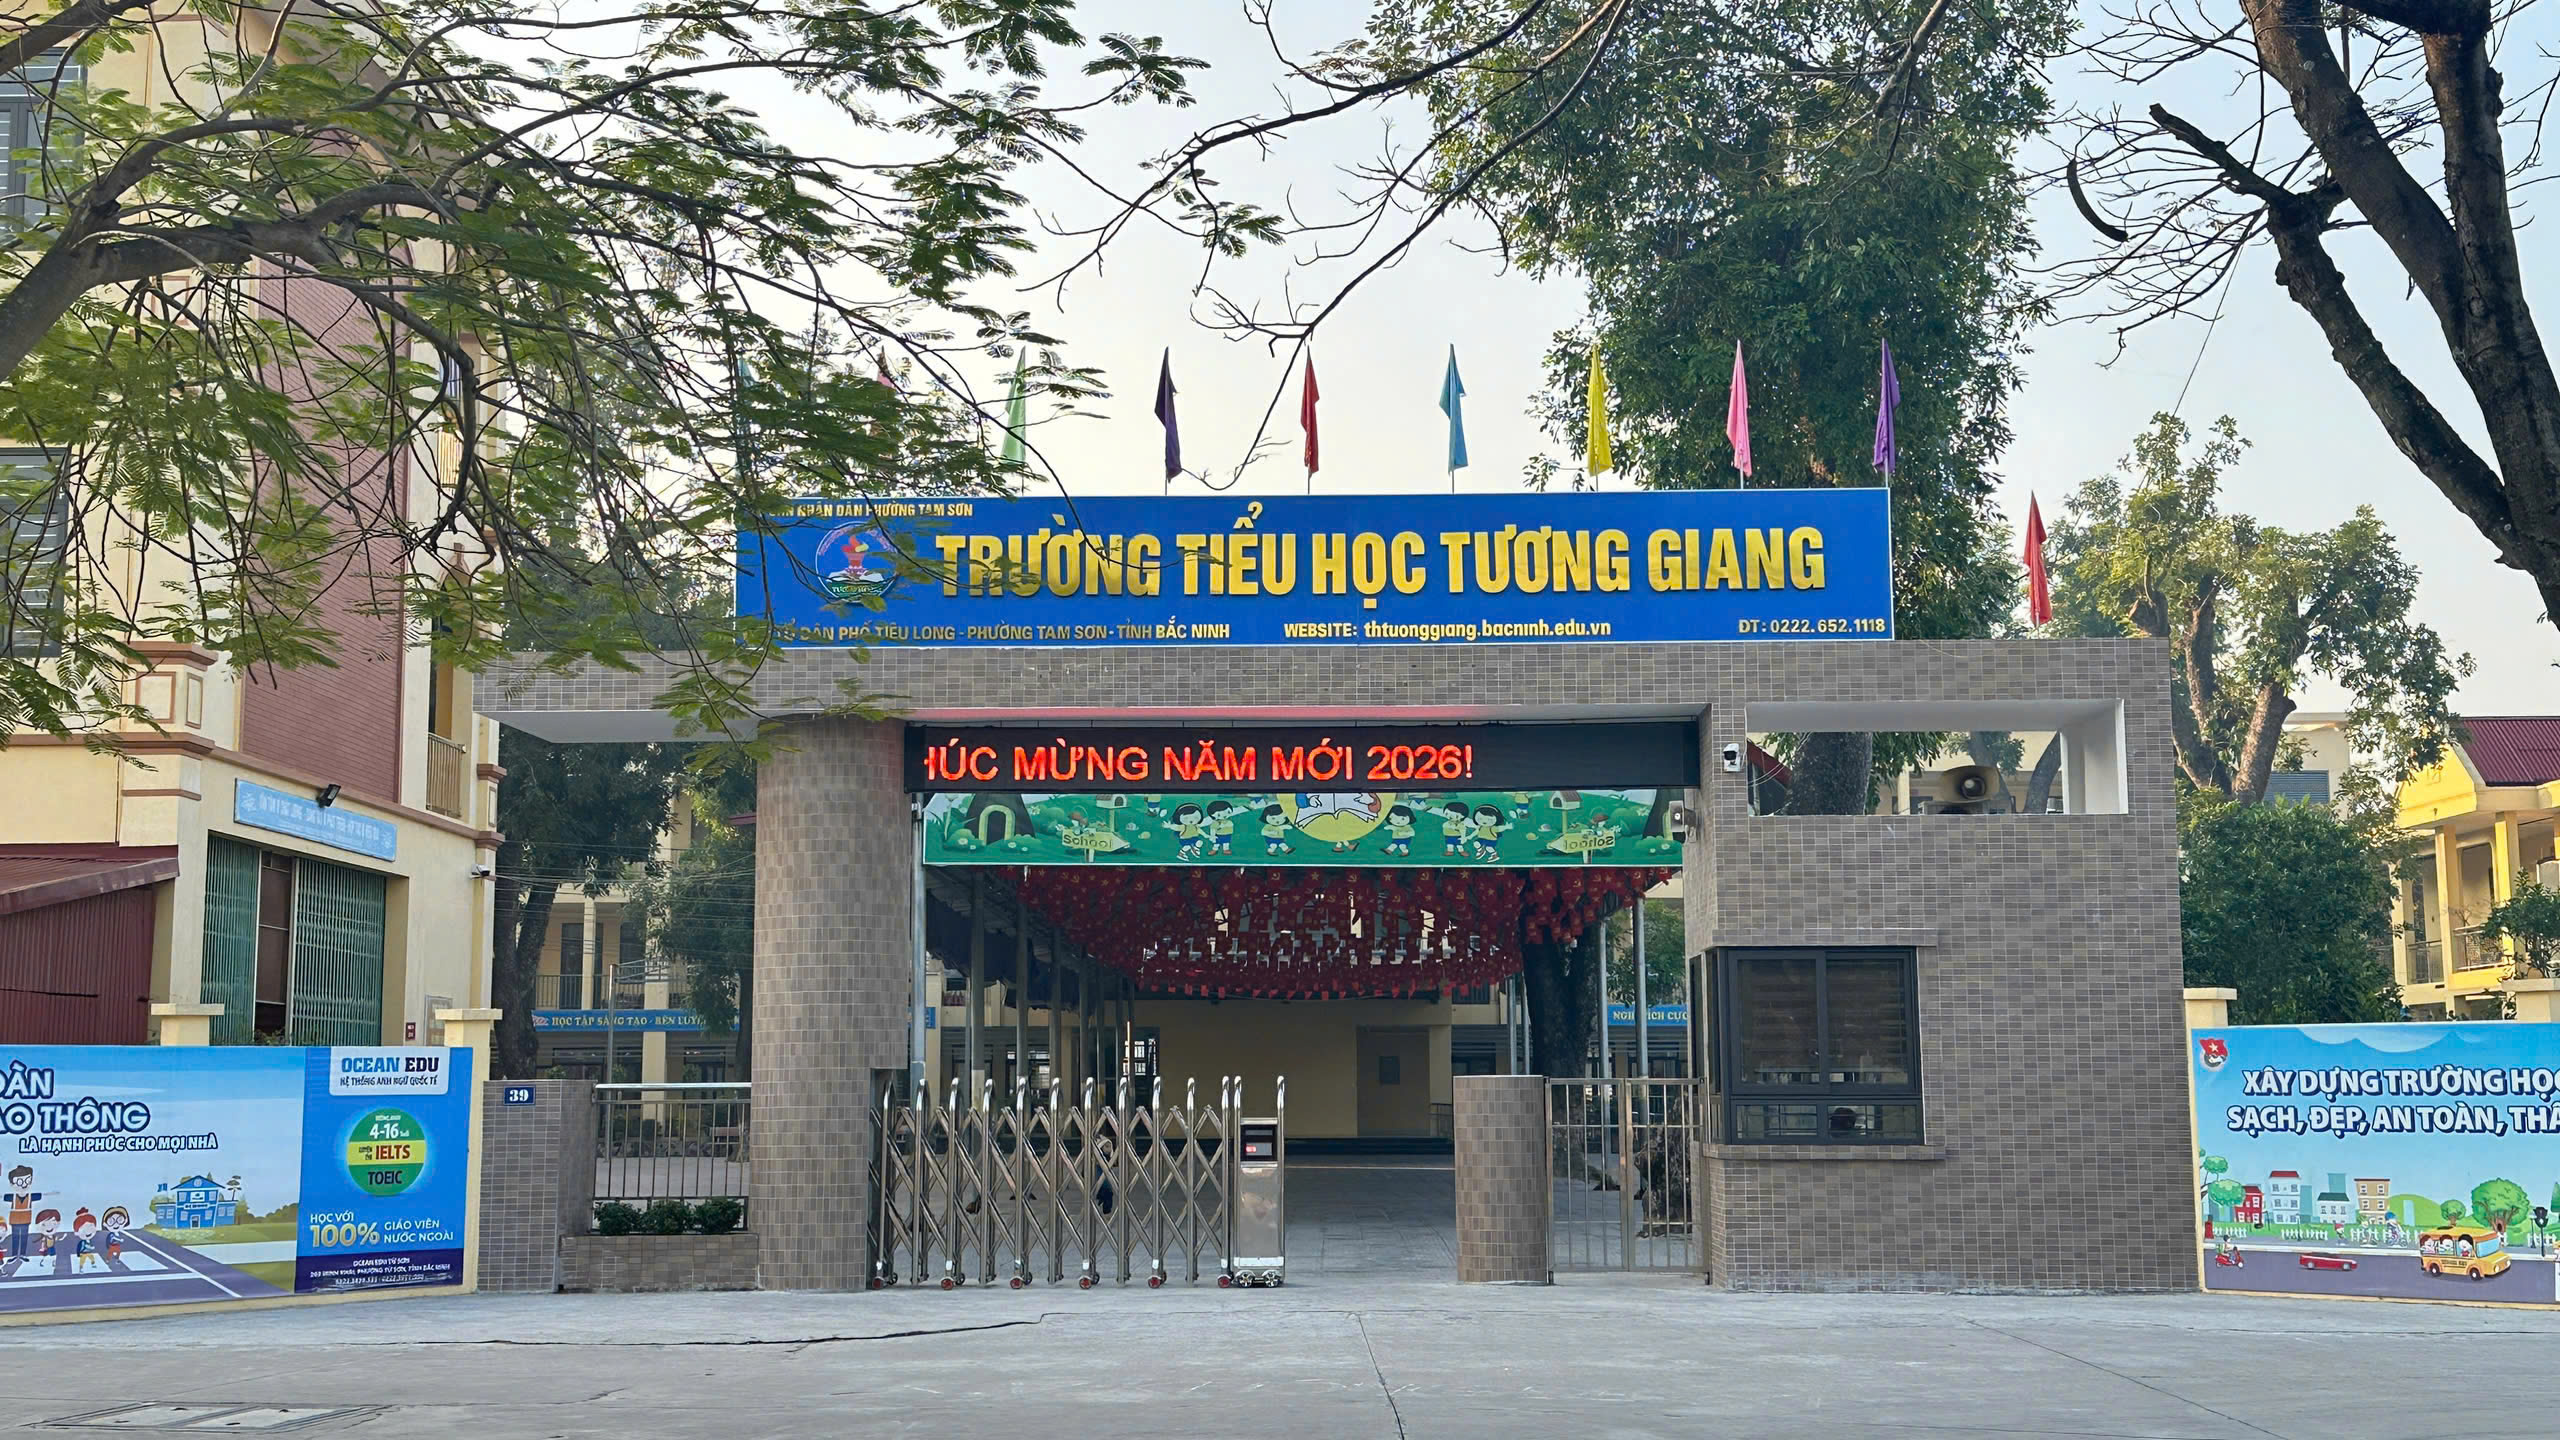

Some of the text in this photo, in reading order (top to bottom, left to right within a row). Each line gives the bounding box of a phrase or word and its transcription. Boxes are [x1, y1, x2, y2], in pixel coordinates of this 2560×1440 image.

[836, 501, 862, 517] DÂN
[918, 503, 945, 517] TAM
[947, 502, 973, 517] SƠN
[935, 513, 1161, 598] TRƯỜNG
[1177, 501, 1298, 596] TIỂU
[1312, 530, 1426, 609] HỌC
[1440, 524, 1631, 594] TƯƠNG
[1646, 526, 1825, 592] GIANG
[913, 625, 956, 641] LONG
[967, 619, 1033, 640] PHƯỜNG
[1036, 625, 1070, 640] TAM
[1155, 615, 1187, 639] BẮC
[1191, 623, 1230, 638] NINH
[1284, 622, 1357, 638] WEBSITE:
[1738, 618, 1886, 633] ĐT: 0222.652.1118
[1013, 737, 1149, 781] MỪNG
[1163, 739, 1257, 781] NĂM
[1271, 737, 1353, 781] MỚI
[1367, 744, 1473, 780] 2026!
[1063, 834, 1113, 849] School
[552, 1016, 572, 1027] HỌC
[626, 1016, 648, 1027] TẠO
[341, 1056, 439, 1073] OCEAN EDU
[2243, 1066, 2296, 1096] XÂY
[2299, 1066, 2382, 1101] DỰNG
[2384, 1064, 2507, 1096] TRƯỜNG
[509, 1089, 529, 1102] 39
[38, 1097, 150, 1133] THÔNG
[2227, 1105, 2307, 1137] SẠCH,
[2310, 1105, 2370, 1137] ĐẸP,
[2373, 1106, 2416, 1132] AN
[2417, 1101, 2508, 1136] TOÀN,
[369, 1122, 399, 1139] 4-16
[19, 1132, 218, 1156] LÀ HẠNH PHÚC CHO MỌI NHÀ
[376, 1144, 410, 1160] IELTS
[368, 1170, 403, 1185] TOEIC
[309, 1210, 354, 1225] HỌC VỚI
[384, 1217, 440, 1231] GIÁO VIÊN
[309, 1222, 381, 1248] 100%
[384, 1229, 454, 1243] NƯỚC NGOÀI
